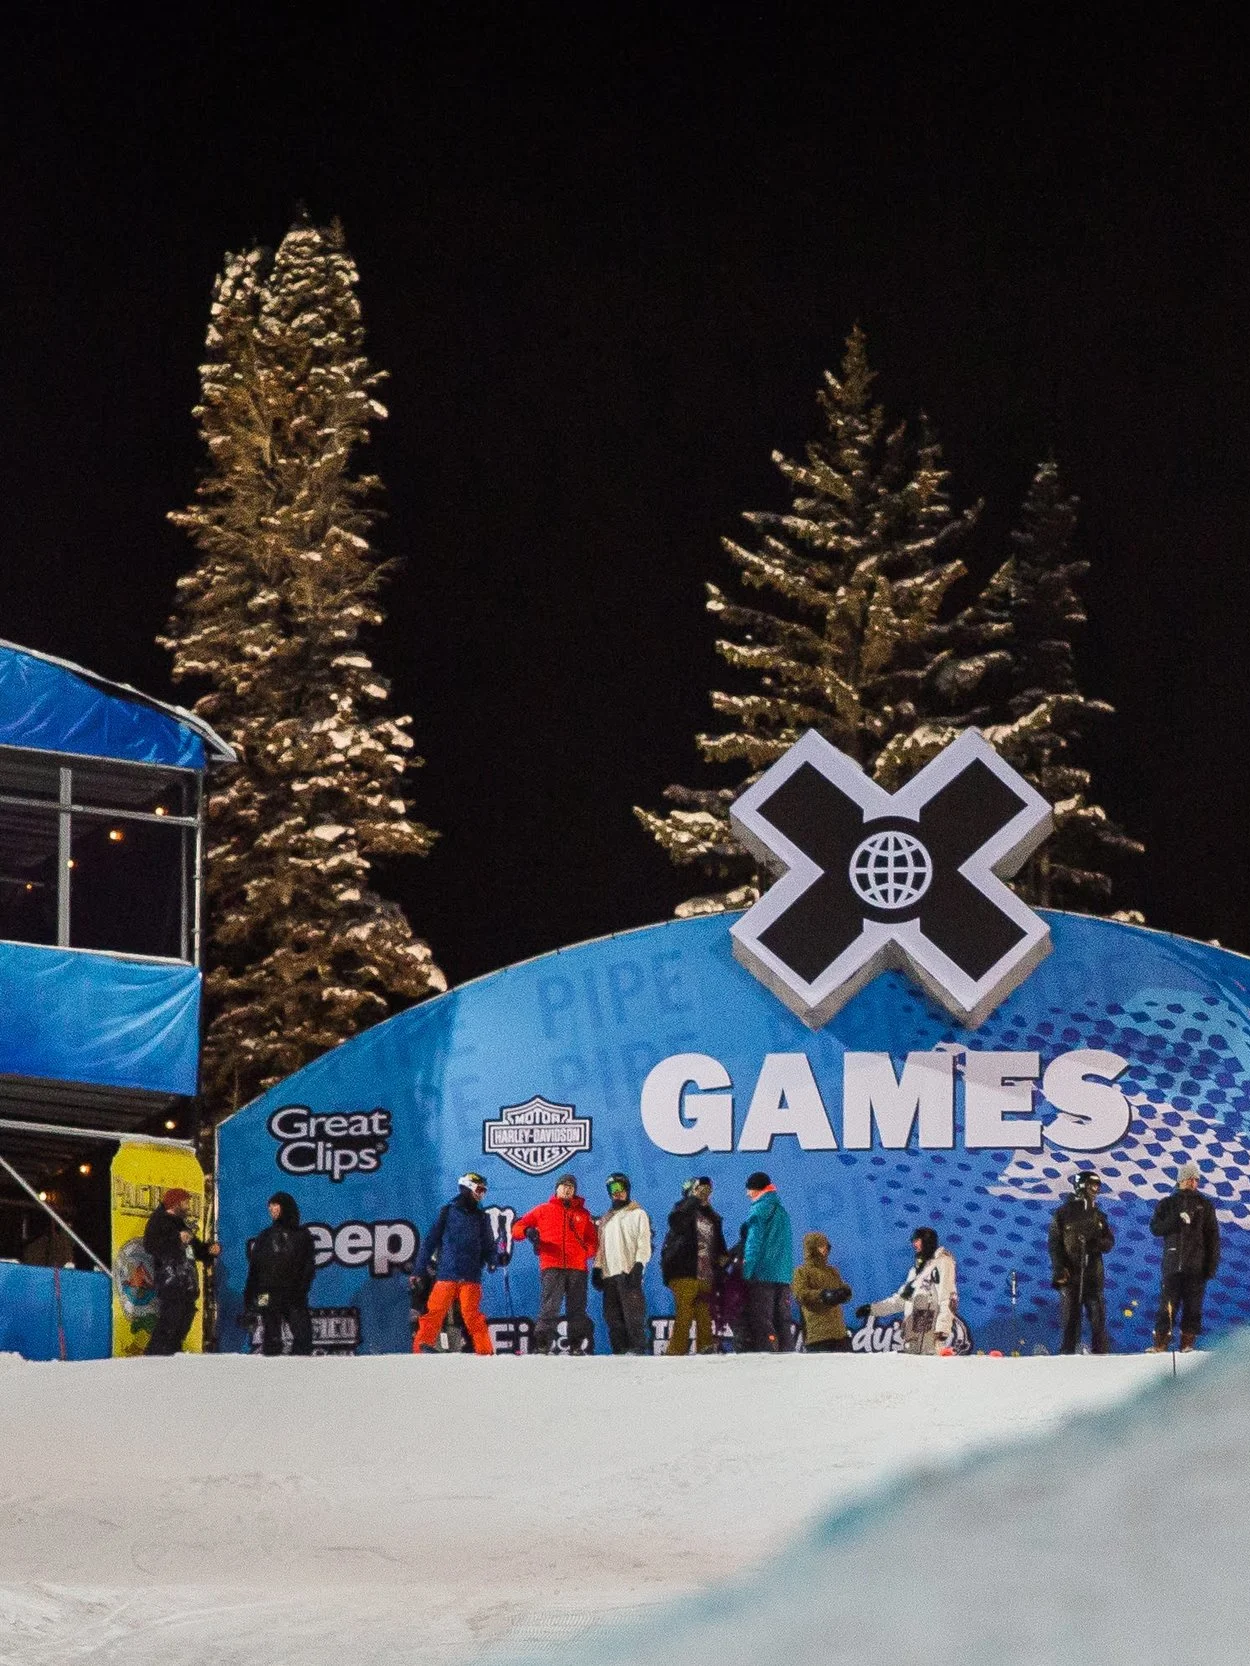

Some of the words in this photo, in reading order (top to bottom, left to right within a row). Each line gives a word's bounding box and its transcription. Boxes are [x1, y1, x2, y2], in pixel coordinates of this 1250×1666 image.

[536, 949, 693, 1039] PIPE
[514, 1108, 564, 1125] MOTOR
[641, 1049, 1132, 1154] GAMES
[271, 1108, 389, 1139] Great
[494, 1127, 581, 1145] HARLEY-DAVIDSON
[280, 1140, 379, 1181] Clips
[513, 1147, 562, 1167] CYCLES
[306, 1223, 417, 1275] eep
